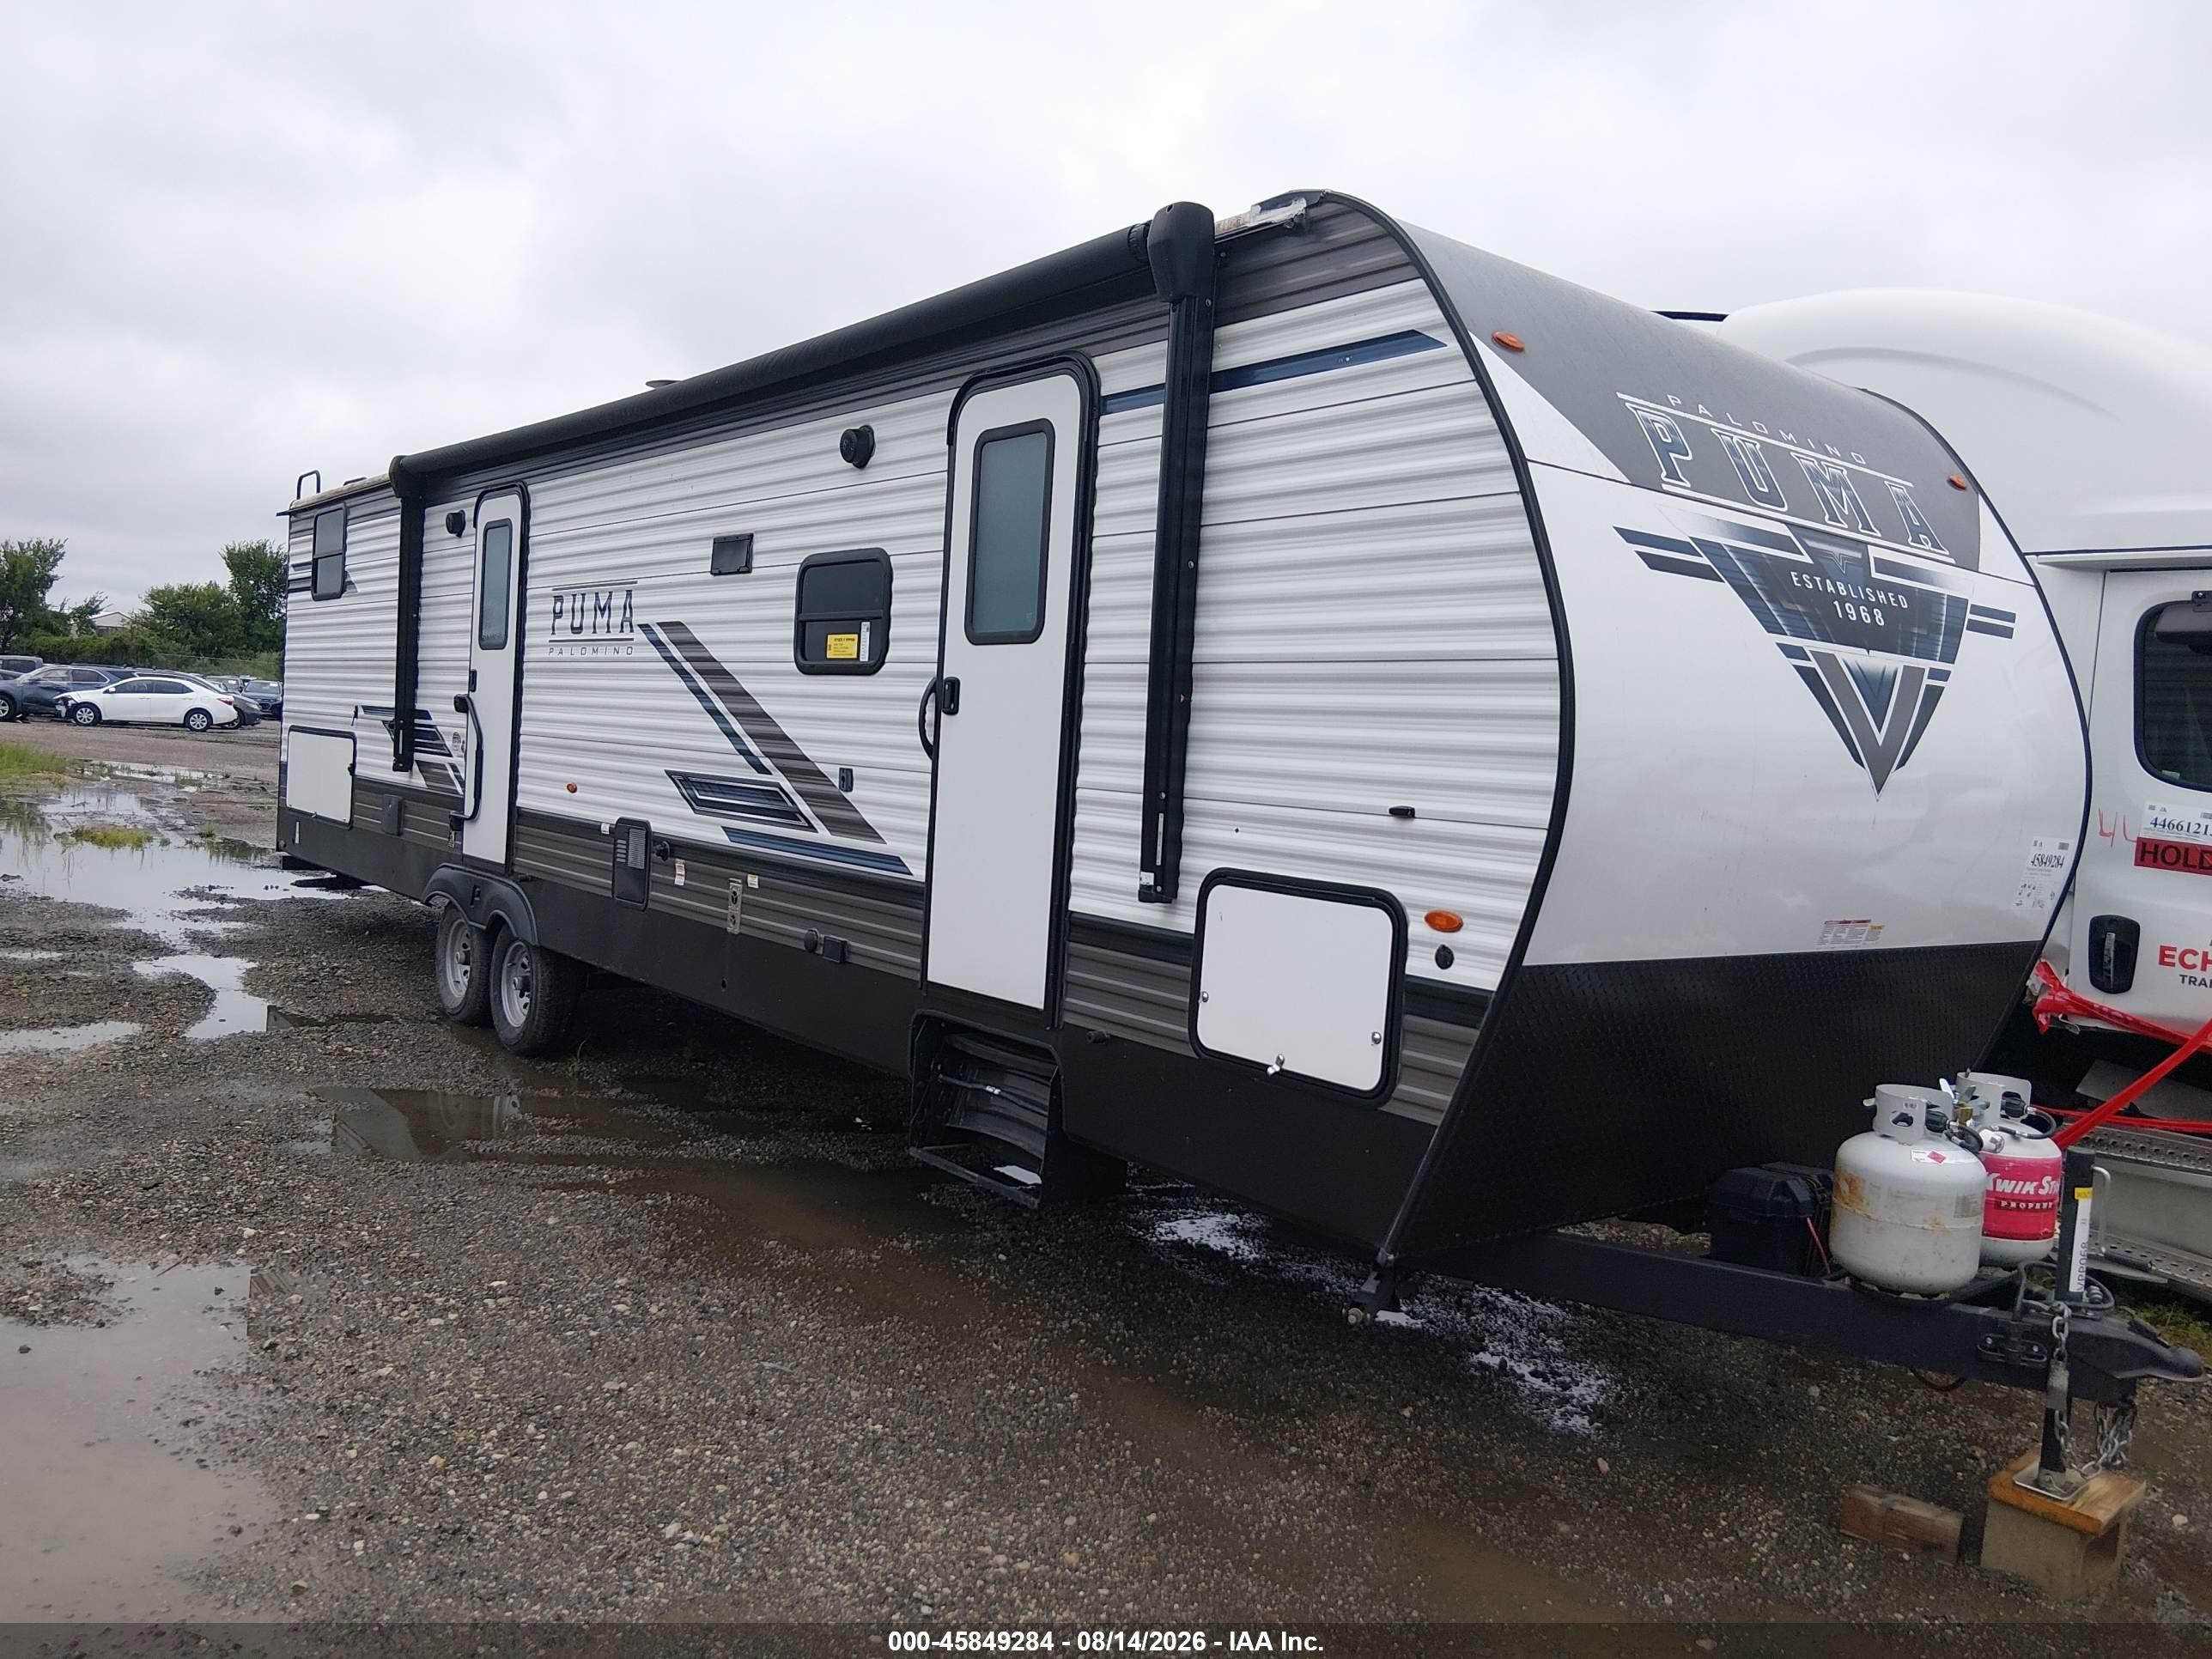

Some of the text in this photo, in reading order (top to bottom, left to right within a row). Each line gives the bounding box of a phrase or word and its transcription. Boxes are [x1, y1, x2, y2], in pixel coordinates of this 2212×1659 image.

[1667, 393, 1866, 465] PALOMINO
[1625, 402, 1950, 556] PUMA
[1790, 571, 1908, 609] ESTABLISHED
[550, 589, 635, 635] PUMA
[1833, 600, 1885, 626] 1968
[548, 646, 634, 656] PALOMINO
[2030, 853, 2065, 869] 45849284
[2179, 974, 2212, 989] TRA
